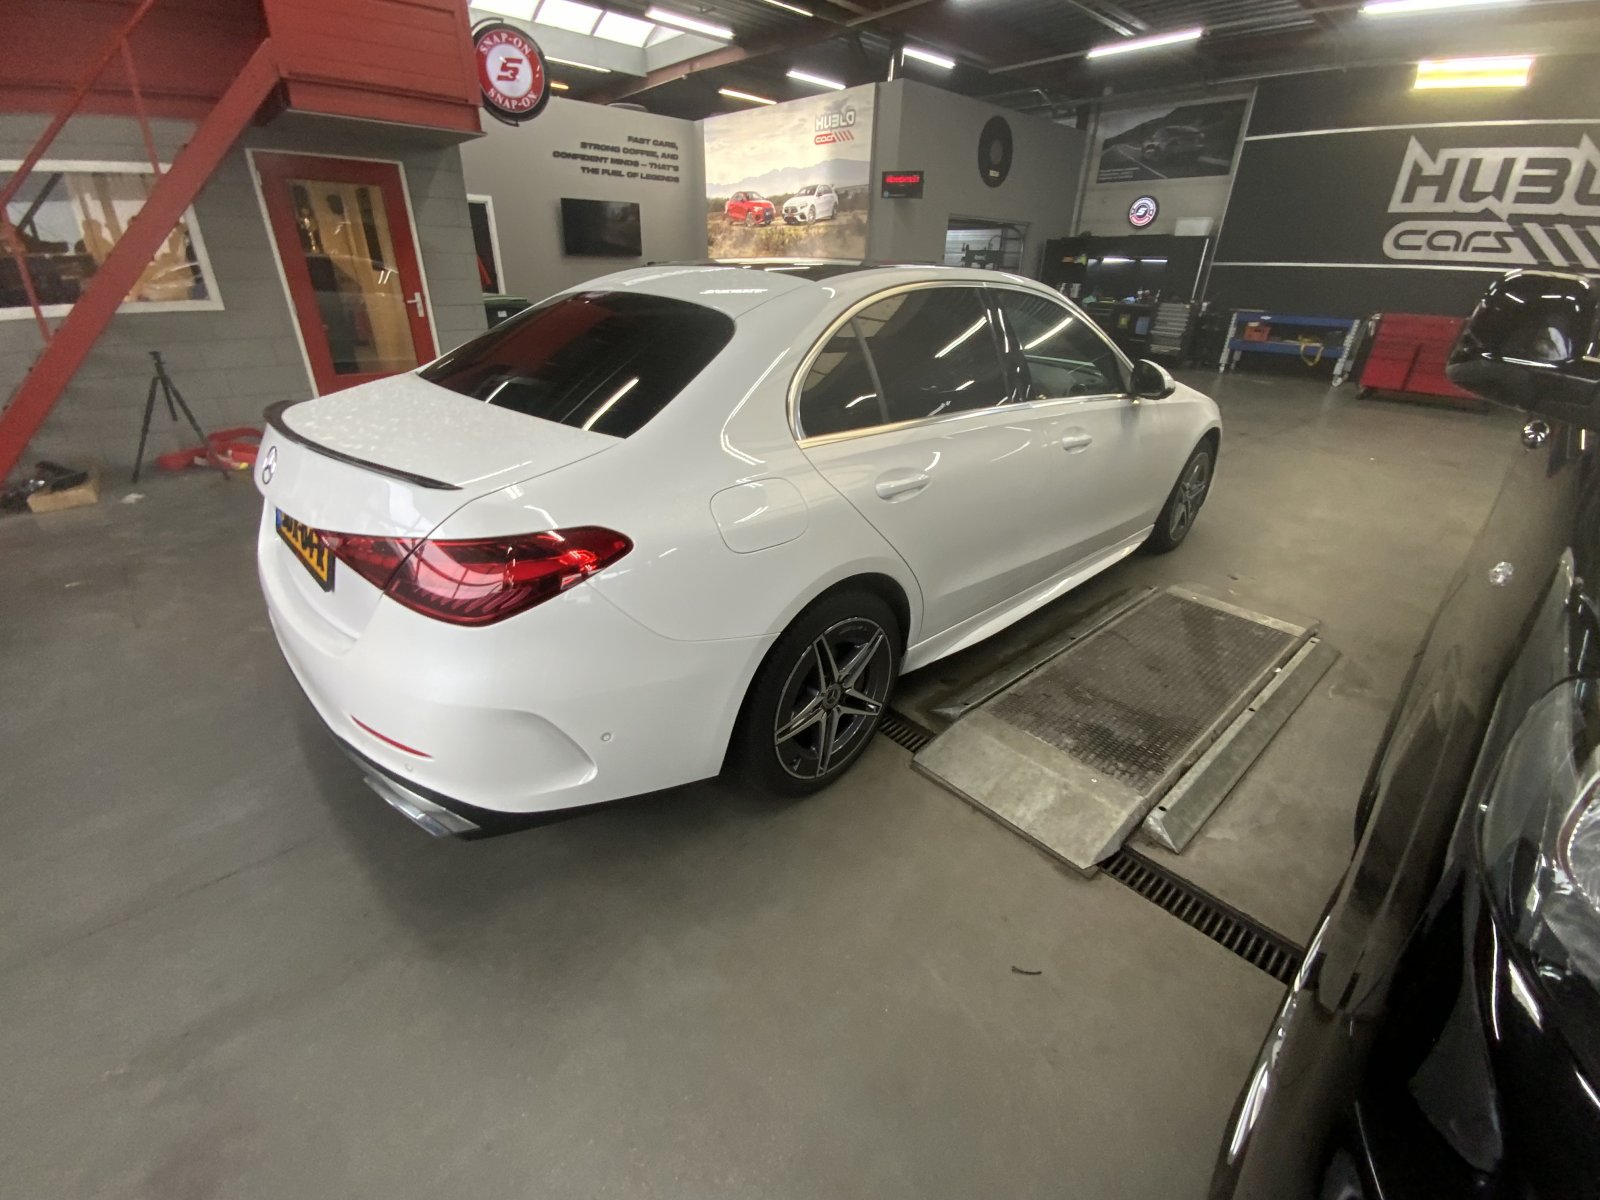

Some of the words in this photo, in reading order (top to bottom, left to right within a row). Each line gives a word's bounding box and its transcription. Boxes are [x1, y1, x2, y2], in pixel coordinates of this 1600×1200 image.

[479, 32, 532, 55] SNAP-ON
[487, 87, 538, 109] SNAP-ON
[580, 141, 621, 153] STRONG
[622, 147, 659, 159] COFFEE,
[660, 152, 679, 160] AND
[627, 135, 652, 145] FAST
[652, 139, 679, 150] CARS,
[552, 150, 609, 163] CONFIDENT
[610, 157, 640, 167] MINDS
[649, 162, 680, 172] THAT'S
[580, 166, 600, 175] THE
[601, 169, 625, 178] FUEL
[626, 171, 640, 179] OF
[640, 173, 680, 183] LEGENDS
